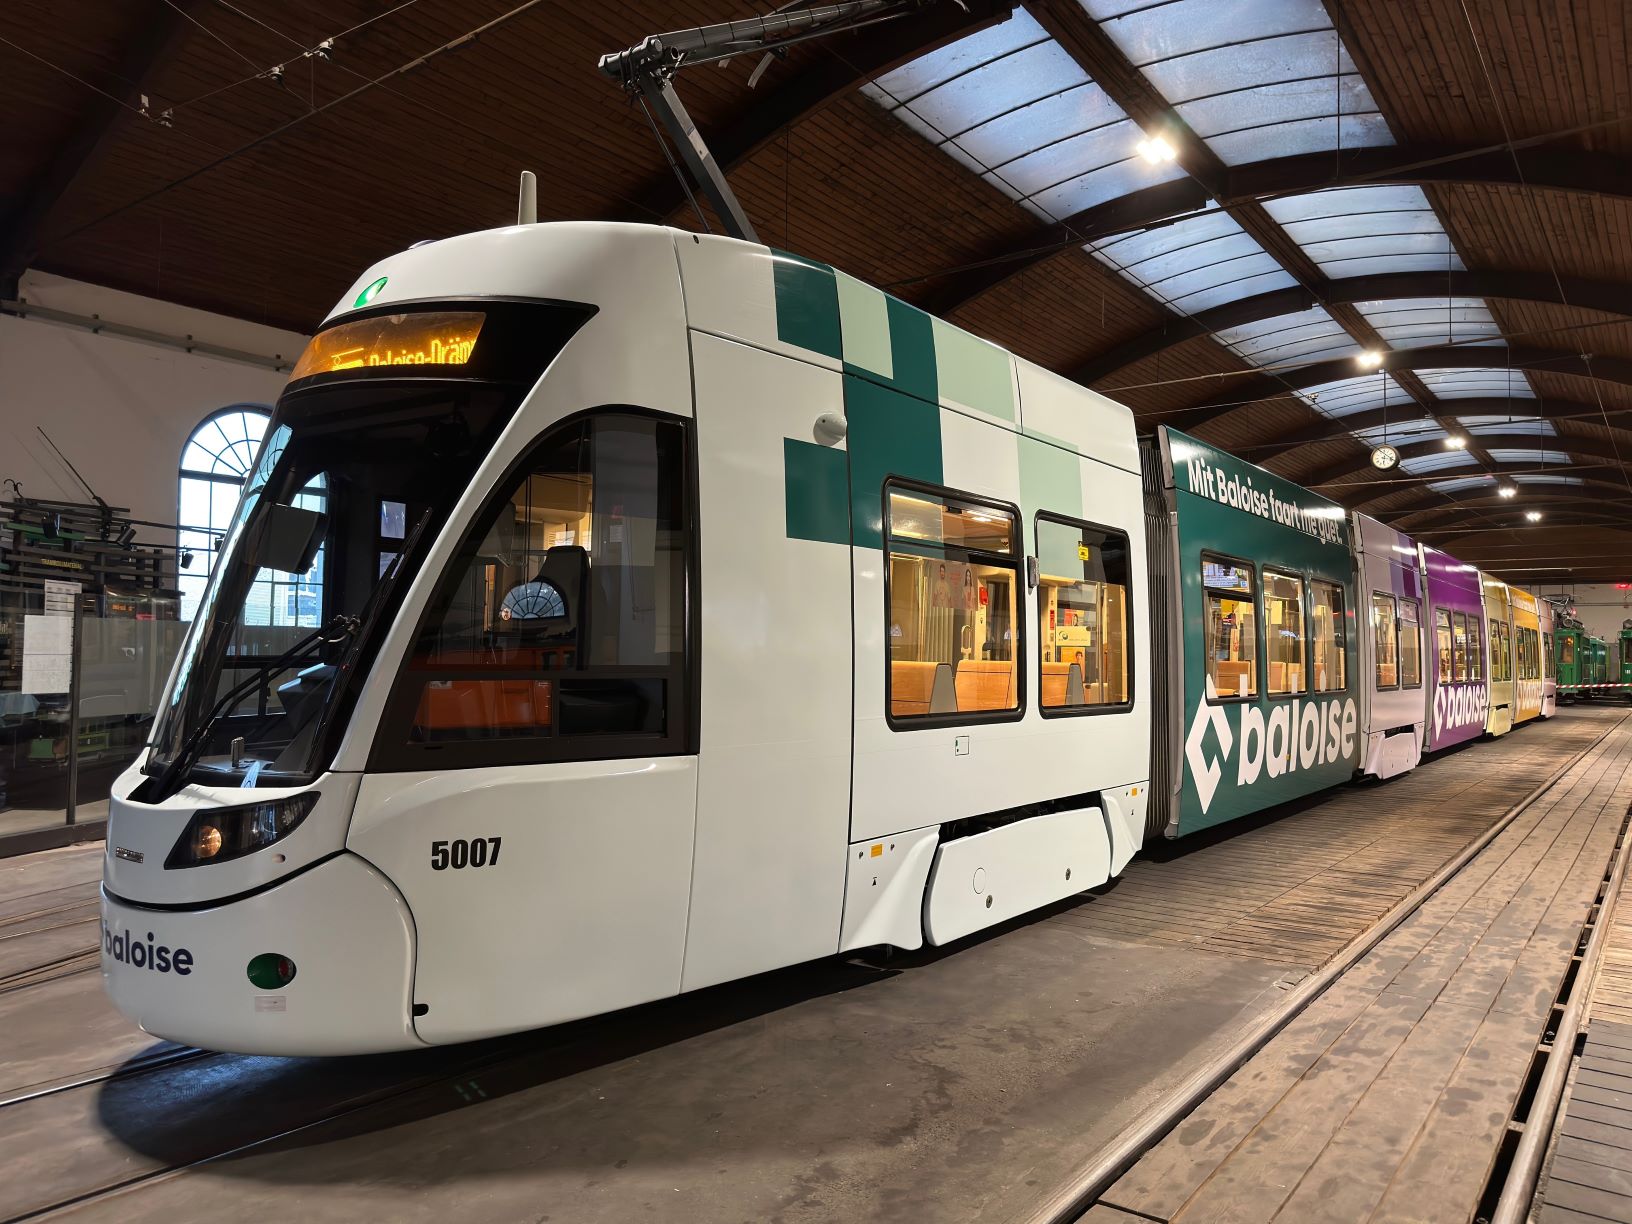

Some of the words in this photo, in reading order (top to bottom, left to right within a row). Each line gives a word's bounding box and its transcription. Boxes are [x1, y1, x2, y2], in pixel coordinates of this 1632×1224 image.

[1187, 457, 1215, 500] Mit
[1215, 468, 1269, 518] Baloise
[1270, 488, 1300, 531] faart
[1237, 670, 1357, 786] baloise
[1446, 668, 1487, 730] baloise
[431, 837, 502, 870] 5007
[104, 920, 194, 975] baloise
